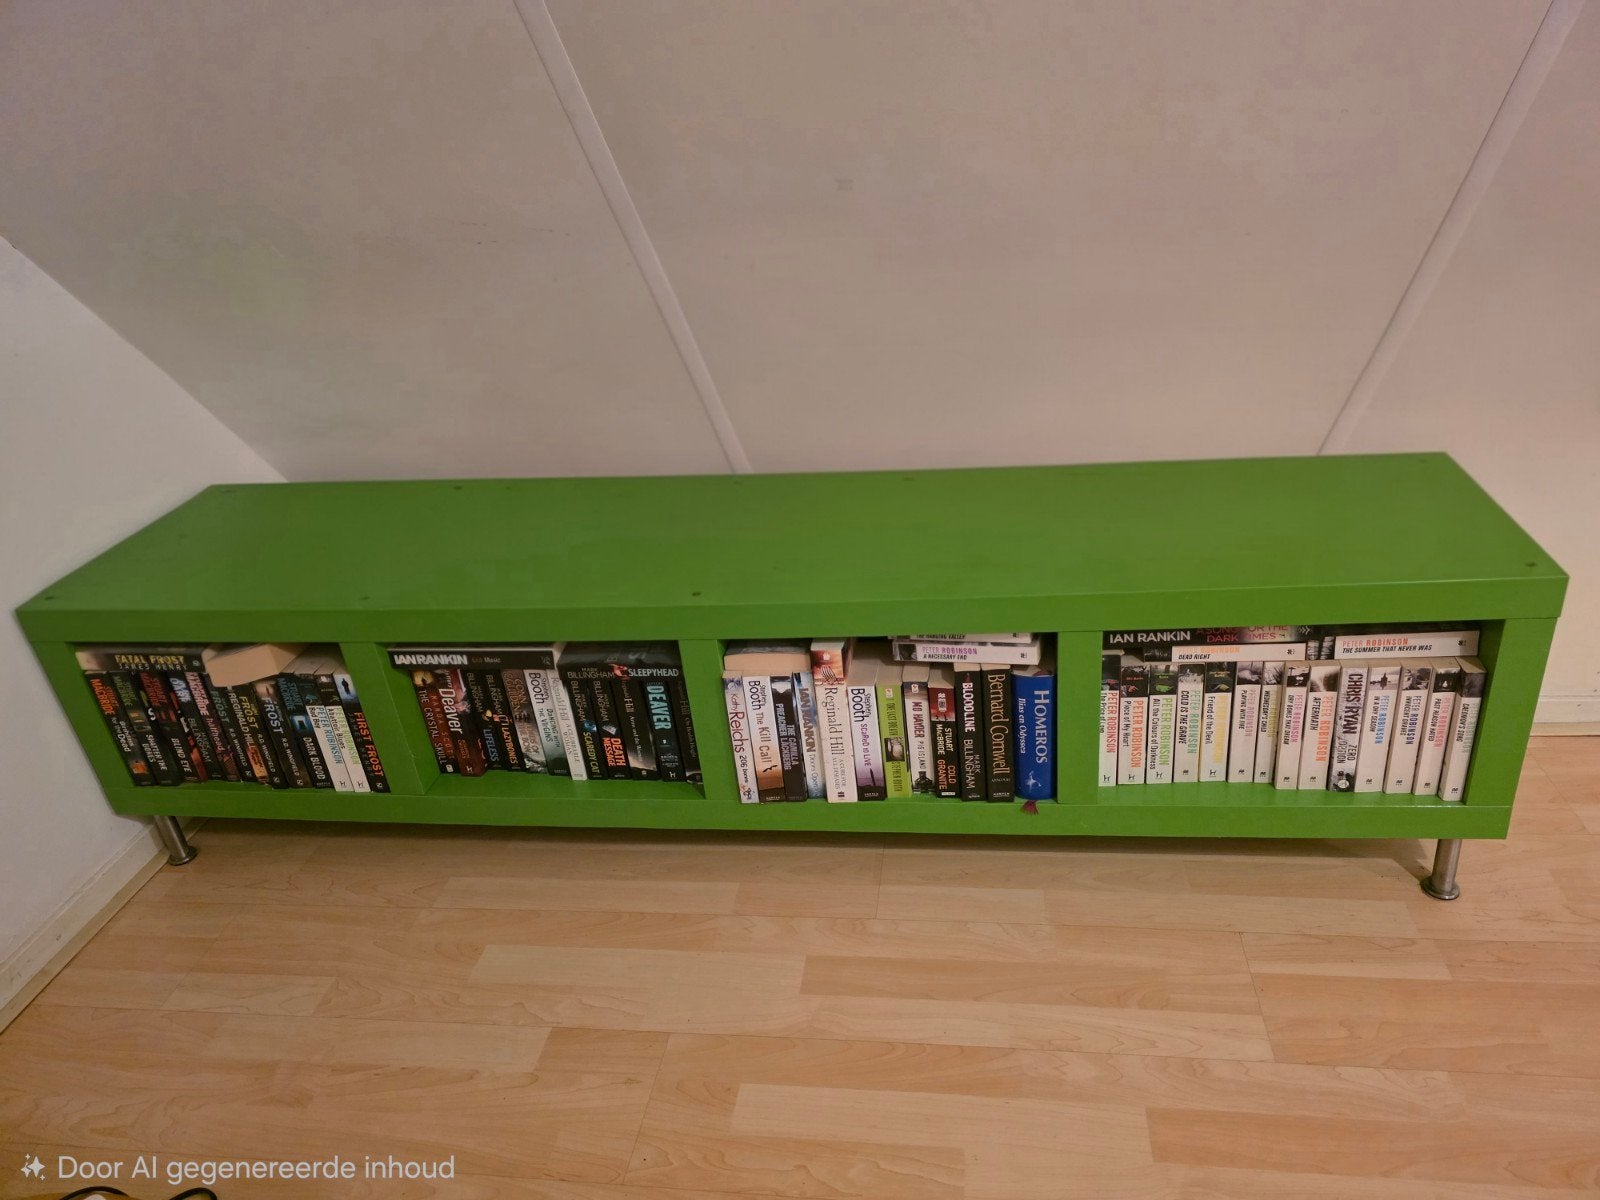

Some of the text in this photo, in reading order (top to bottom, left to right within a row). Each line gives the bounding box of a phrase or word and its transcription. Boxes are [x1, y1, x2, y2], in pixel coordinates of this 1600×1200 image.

[941, 647, 978, 655] ROBINSON
[1109, 631, 1191, 644] IAN RANKIN
[1207, 634, 1239, 643] DARK
[1342, 638, 1408, 647] PETER ROBINSON
[114, 654, 185, 665] FATAL FROST
[393, 654, 468, 665] IAN RANKIN
[567, 671, 615, 679] BILLINGHAM
[627, 668, 679, 677] SLEEPYHEAD
[90, 678, 116, 716] MACBRIDE
[467, 672, 484, 713] BILLINGHAM
[485, 674, 504, 714] BILLINGHAM
[514, 678, 528, 705] CONN
[528, 671, 545, 705] Booth
[571, 680, 587, 722] BILLINGHAM
[593, 681, 609, 722] BILLINGHAM
[748, 680, 761, 711] Booth
[987, 673, 1010, 723] Bernard
[1153, 698, 1161, 708] All
[1180, 690, 1190, 706] COLD
[1287, 694, 1295, 705] DRY
[1342, 673, 1364, 735] CHRIS RYAN
[210, 690, 230, 723] FROST
[239, 696, 259, 729] FROST
[263, 697, 284, 734] FROST
[308, 706, 316, 718] Bad
[438, 687, 464, 735] Deaver
[624, 698, 635, 713] Hill
[646, 685, 672, 730] DEAVER
[775, 703, 787, 737] PREACHER
[800, 687, 816, 753] IAN RANKIN
[822, 686, 845, 756] Reginald Hill
[851, 687, 866, 723] Booth
[864, 692, 872, 718] Stephen
[912, 701, 923, 711] MO
[962, 682, 976, 733] BLOODLINE
[1017, 697, 1027, 724] Ilias en
[1124, 701, 1132, 716] Piece
[1152, 708, 1160, 717] the
[1179, 714, 1188, 725] THE
[1207, 696, 1216, 715] Friend
[1245, 705, 1255, 737] ROBINSON
[1260, 690, 1271, 733] WEDNESDAY'S CHILD
[1309, 696, 1322, 731] AFTERMATH
[1372, 706, 1380, 716] DRY
[1375, 695, 1389, 744] PETER ROBINSON
[1400, 696, 1412, 736] INNOCENT GRAVES
[1405, 695, 1422, 745] PETER ROBINSON
[227, 692, 256, 751] REGINALD HILL
[418, 689, 448, 765] THE CRYSTAL SKULL
[786, 724, 795, 736] THE
[913, 712, 925, 739] HAYDER
[1033, 689, 1050, 764] HOMEROS
[1106, 692, 1118, 753] PETER ROBINSON
[1122, 723, 1131, 731] My
[1130, 700, 1144, 769] PETER ROBINSON
[1151, 717, 1160, 738] Colours
[1178, 726, 1187, 745] GRAVE
[1187, 712, 1200, 754] ROBINSON
[1206, 721, 1214, 731] the
[1291, 711, 1302, 743] ROBINSON
[1315, 695, 1334, 762] PETER ROBINSON
[1369, 715, 1378, 733] SEASON
[117, 733, 131, 752] Dead
[142, 743, 156, 763] BONES
[146, 734, 168, 771] SHATTER THE
[324, 728, 343, 765] ROBINSON
[353, 711, 384, 777] FIRST FROST
[483, 728, 500, 762] LIFELESS
[501, 726, 519, 764] LAZYBONES
[583, 731, 600, 774] SCAREDY CAT
[602, 737, 616, 767] MESSAGE
[611, 737, 627, 767] DEATH
[729, 711, 749, 768] Reichs 206
[755, 712, 772, 764] The Kill Call
[788, 737, 799, 766] CAMILLA
[944, 727, 954, 752] STUART
[989, 724, 1011, 775] Cornwell
[1122, 731, 1130, 747] Heart
[1158, 722, 1172, 766] ROBINSON
[1205, 731, 1213, 745] Devil
[1346, 744, 1358, 761] ZERO
[171, 737, 192, 773] BLIND EYE
[302, 736, 326, 780] DARK BLOOD
[963, 739, 976, 788] BILLINGHAM
[1149, 746, 1159, 770] Darkness
[937, 759, 948, 790] GRANITE
[947, 765, 957, 784] COLD
